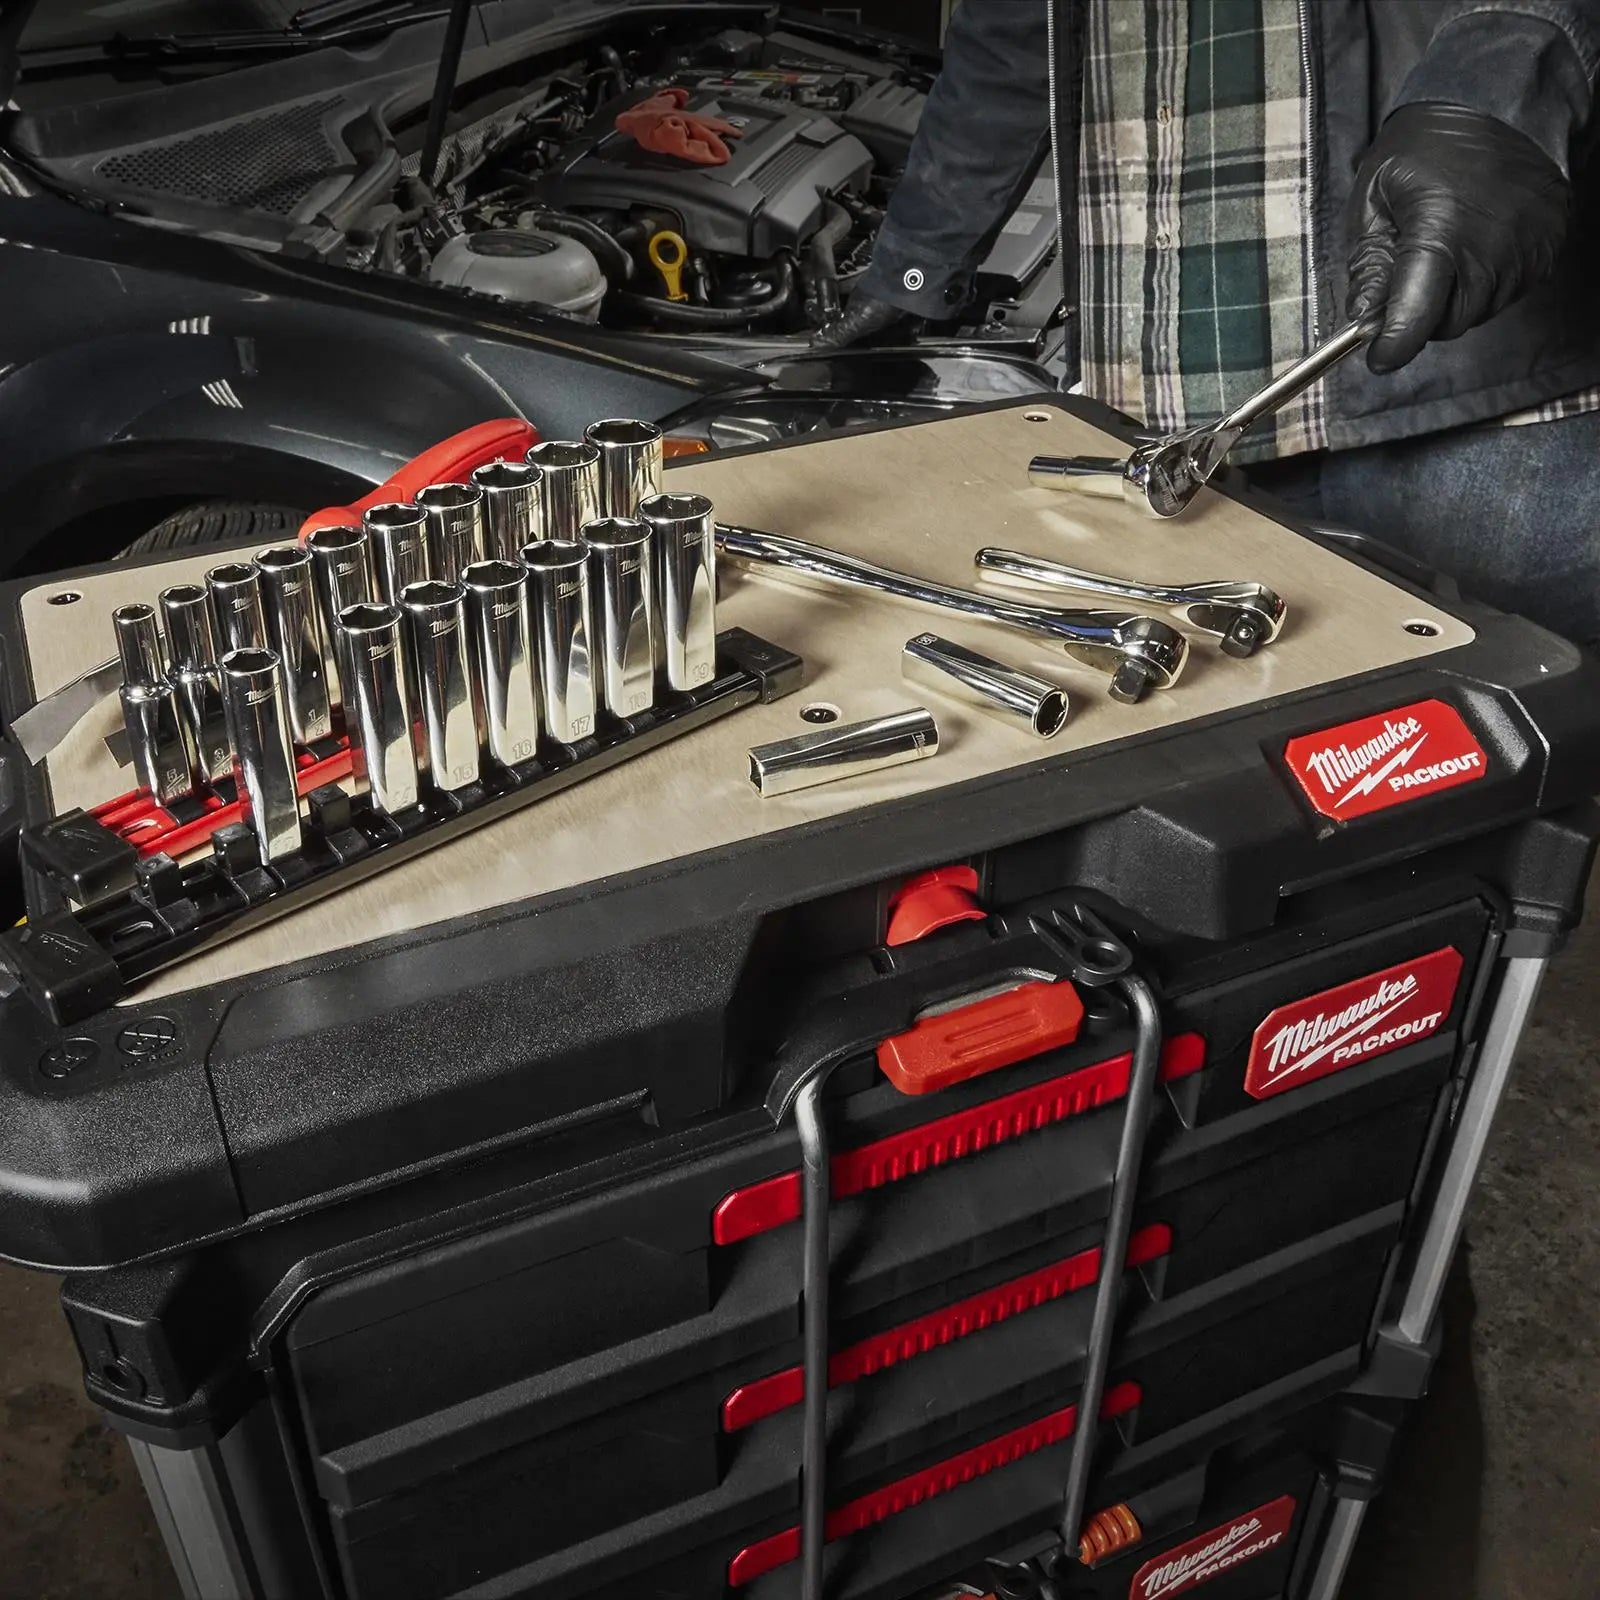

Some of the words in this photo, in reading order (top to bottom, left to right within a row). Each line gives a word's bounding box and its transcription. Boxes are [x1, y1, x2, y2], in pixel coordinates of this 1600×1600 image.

[512, 739, 532, 760] 16
[571, 715, 591, 736] 17
[453, 763, 474, 783] 15
[1306, 716, 1423, 794] Milwaukee
[1388, 751, 1480, 792] PACKOUT
[1263, 974, 1417, 1072] Milwaukee
[1332, 1011, 1443, 1063] PACKOUT
[1140, 1517, 1261, 1597] Milwaukee
[1195, 1532, 1283, 1581] PACKOUT
